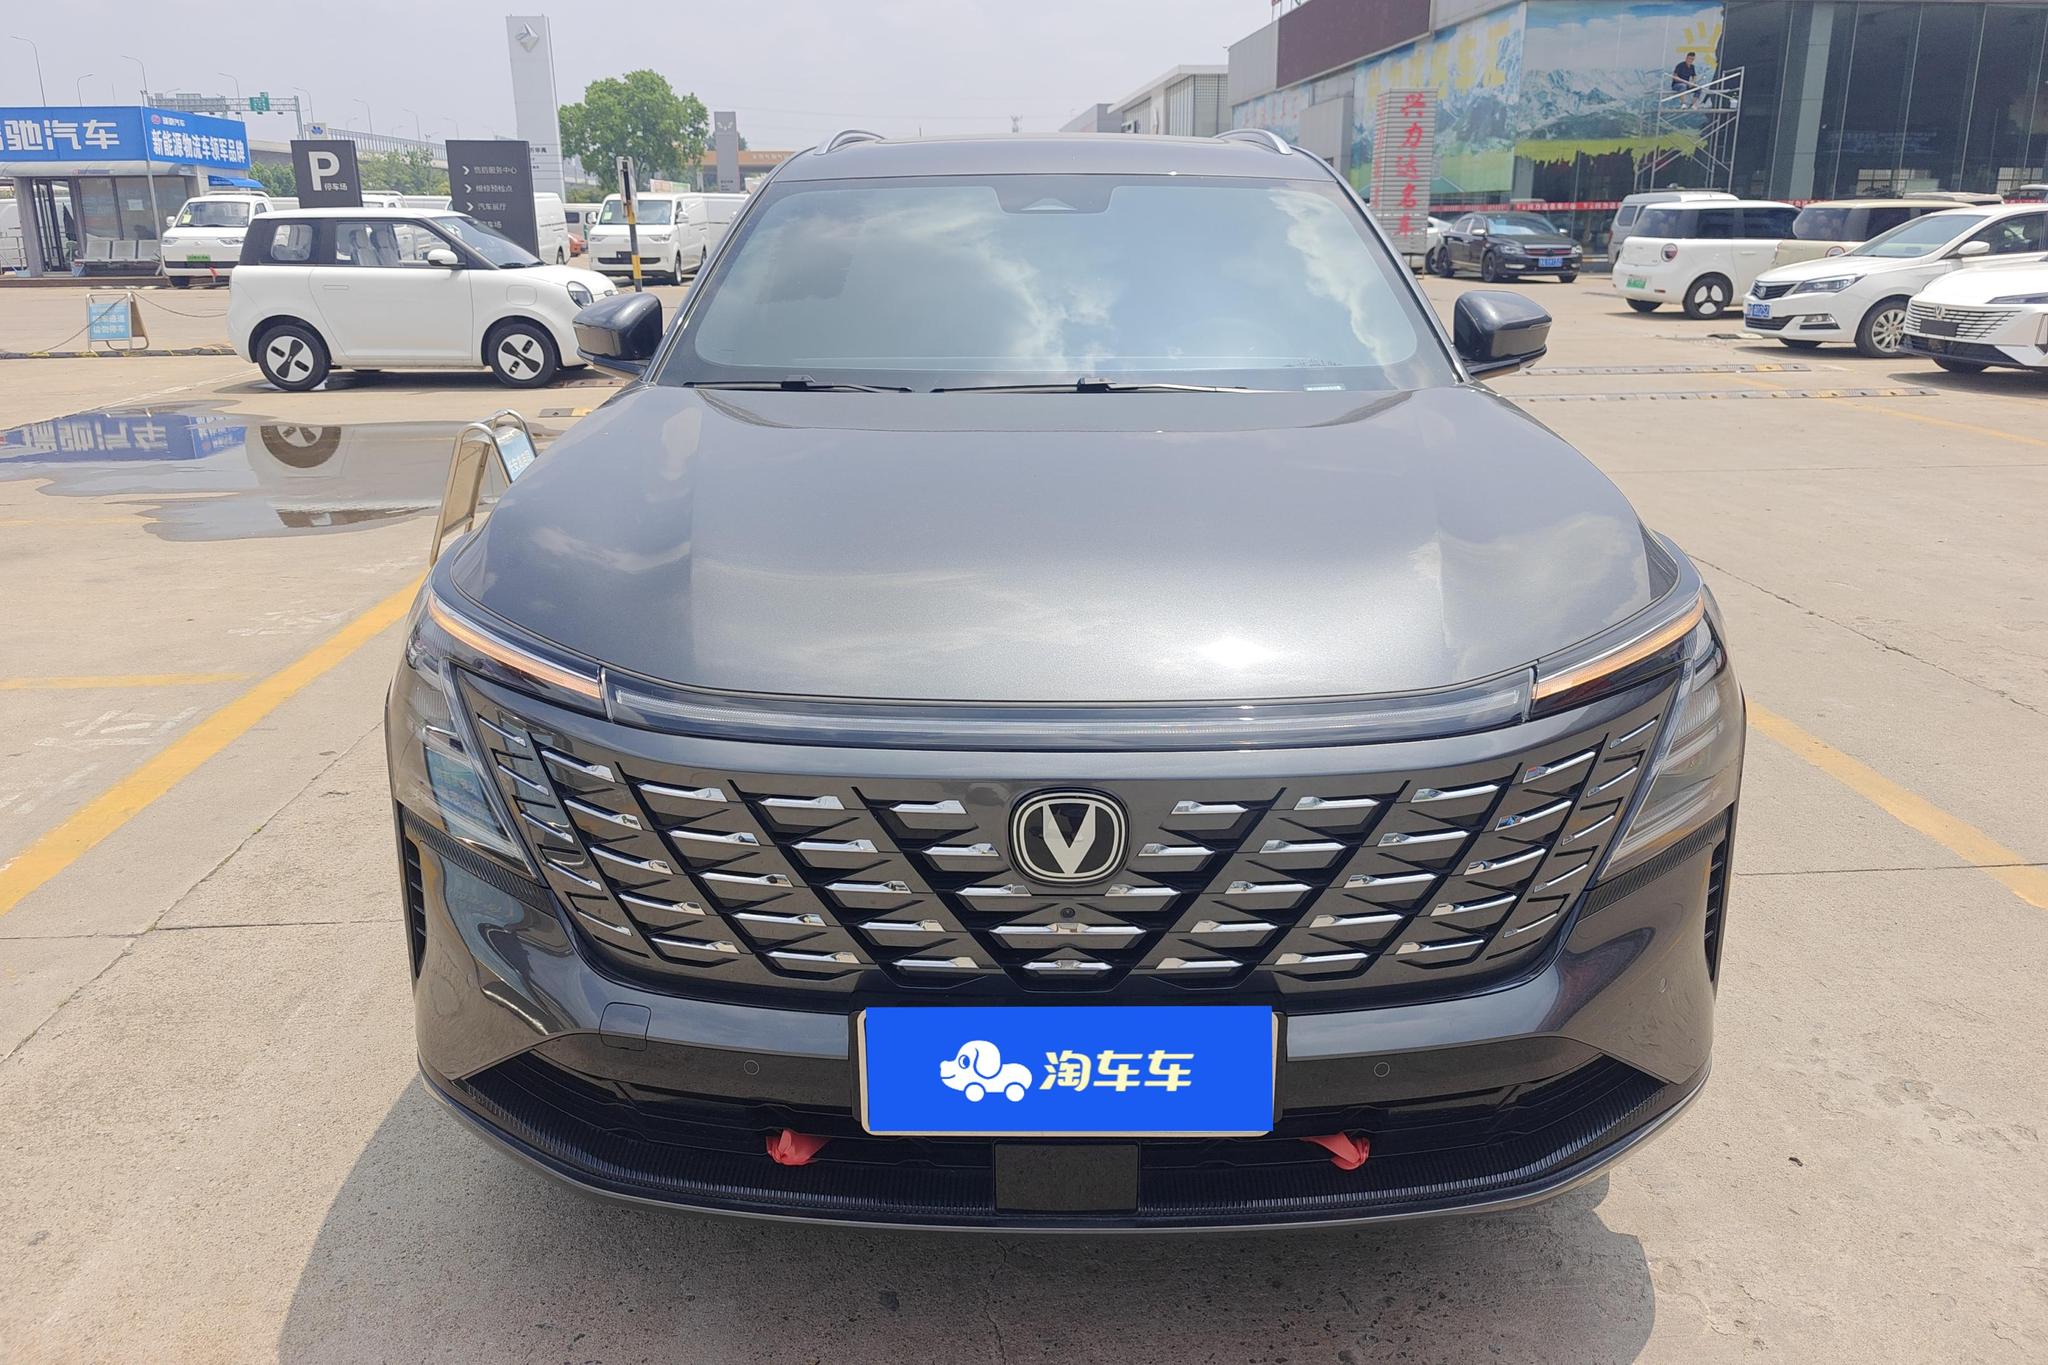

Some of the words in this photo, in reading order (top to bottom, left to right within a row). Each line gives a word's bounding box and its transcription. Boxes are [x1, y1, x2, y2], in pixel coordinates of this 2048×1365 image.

[0, 119, 120, 151] 驰汽车
[151, 129, 246, 164] 新能源物流车领军品牌
[308, 151, 340, 192] P
[473, 166, 518, 175] 售后服务中心
[324, 182, 348, 192] 停车场
